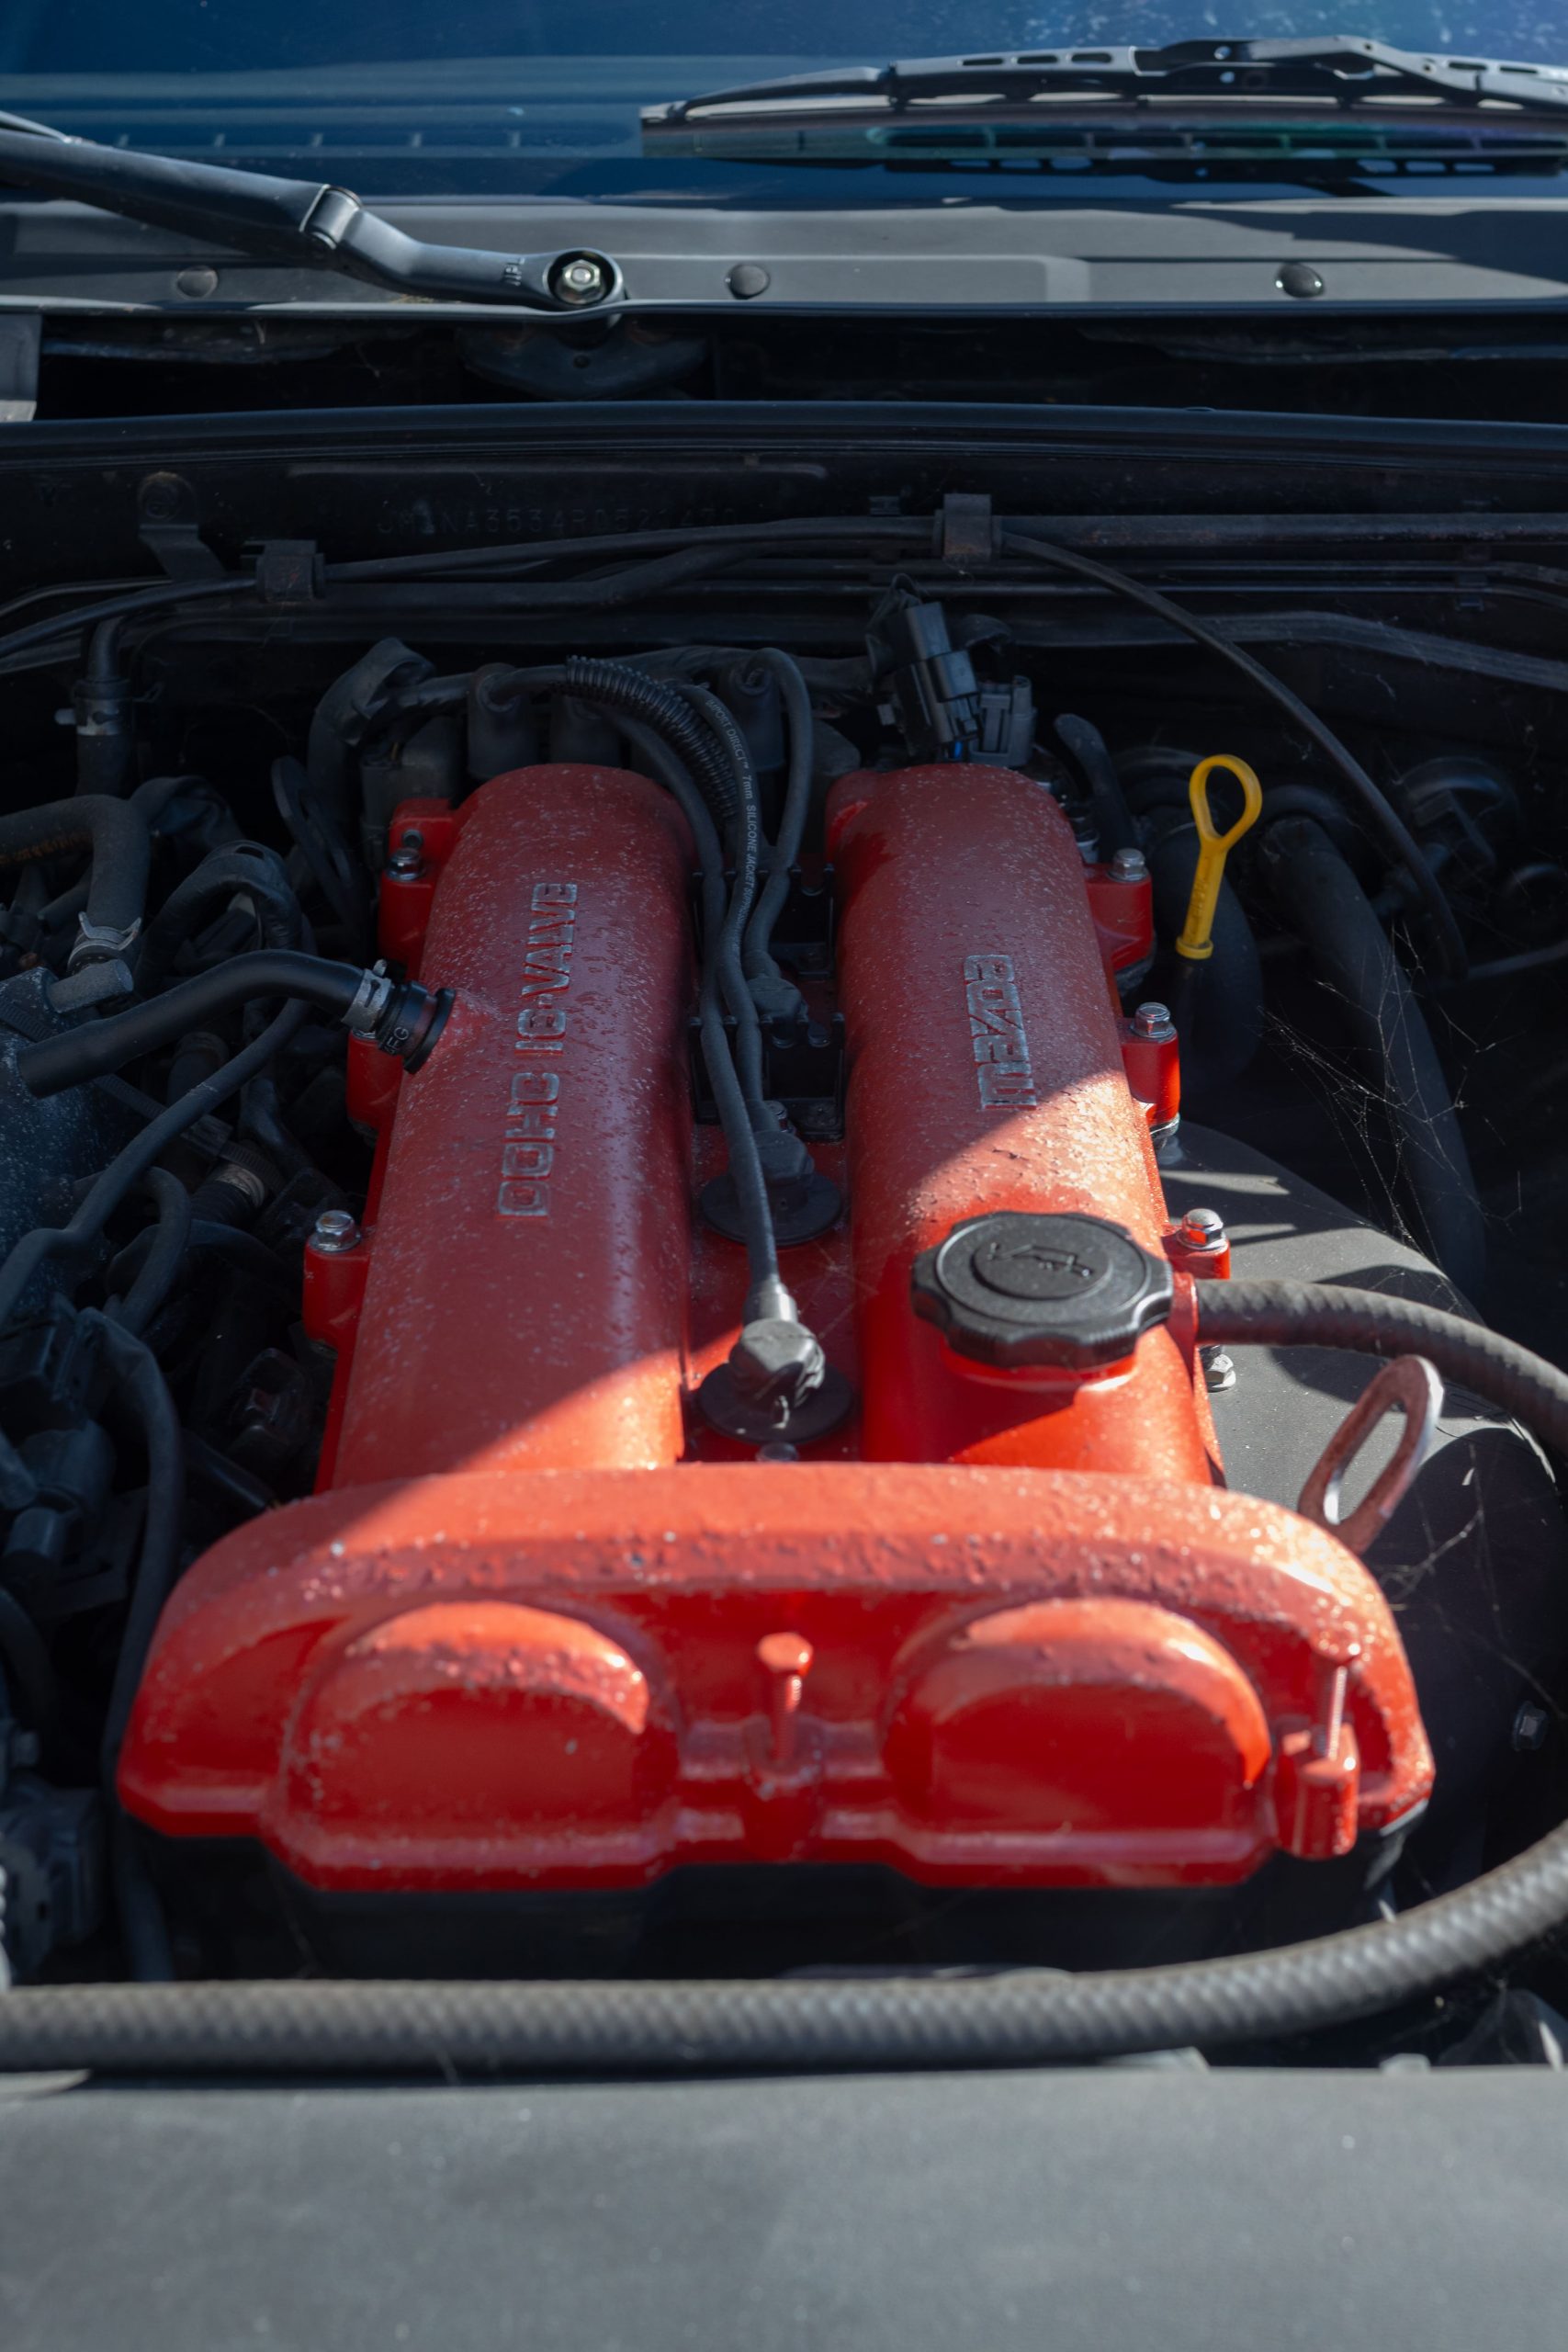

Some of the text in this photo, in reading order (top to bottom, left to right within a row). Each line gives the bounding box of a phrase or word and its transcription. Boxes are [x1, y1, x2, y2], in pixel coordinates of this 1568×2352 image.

[705, 699, 732, 728] IMPORT
[741, 775, 753, 799] 7mm
[746, 804, 758, 853] SILICONE
[745, 853, 757, 888] JACKET
[495, 882, 579, 1218] DOHC 16-VALVE
